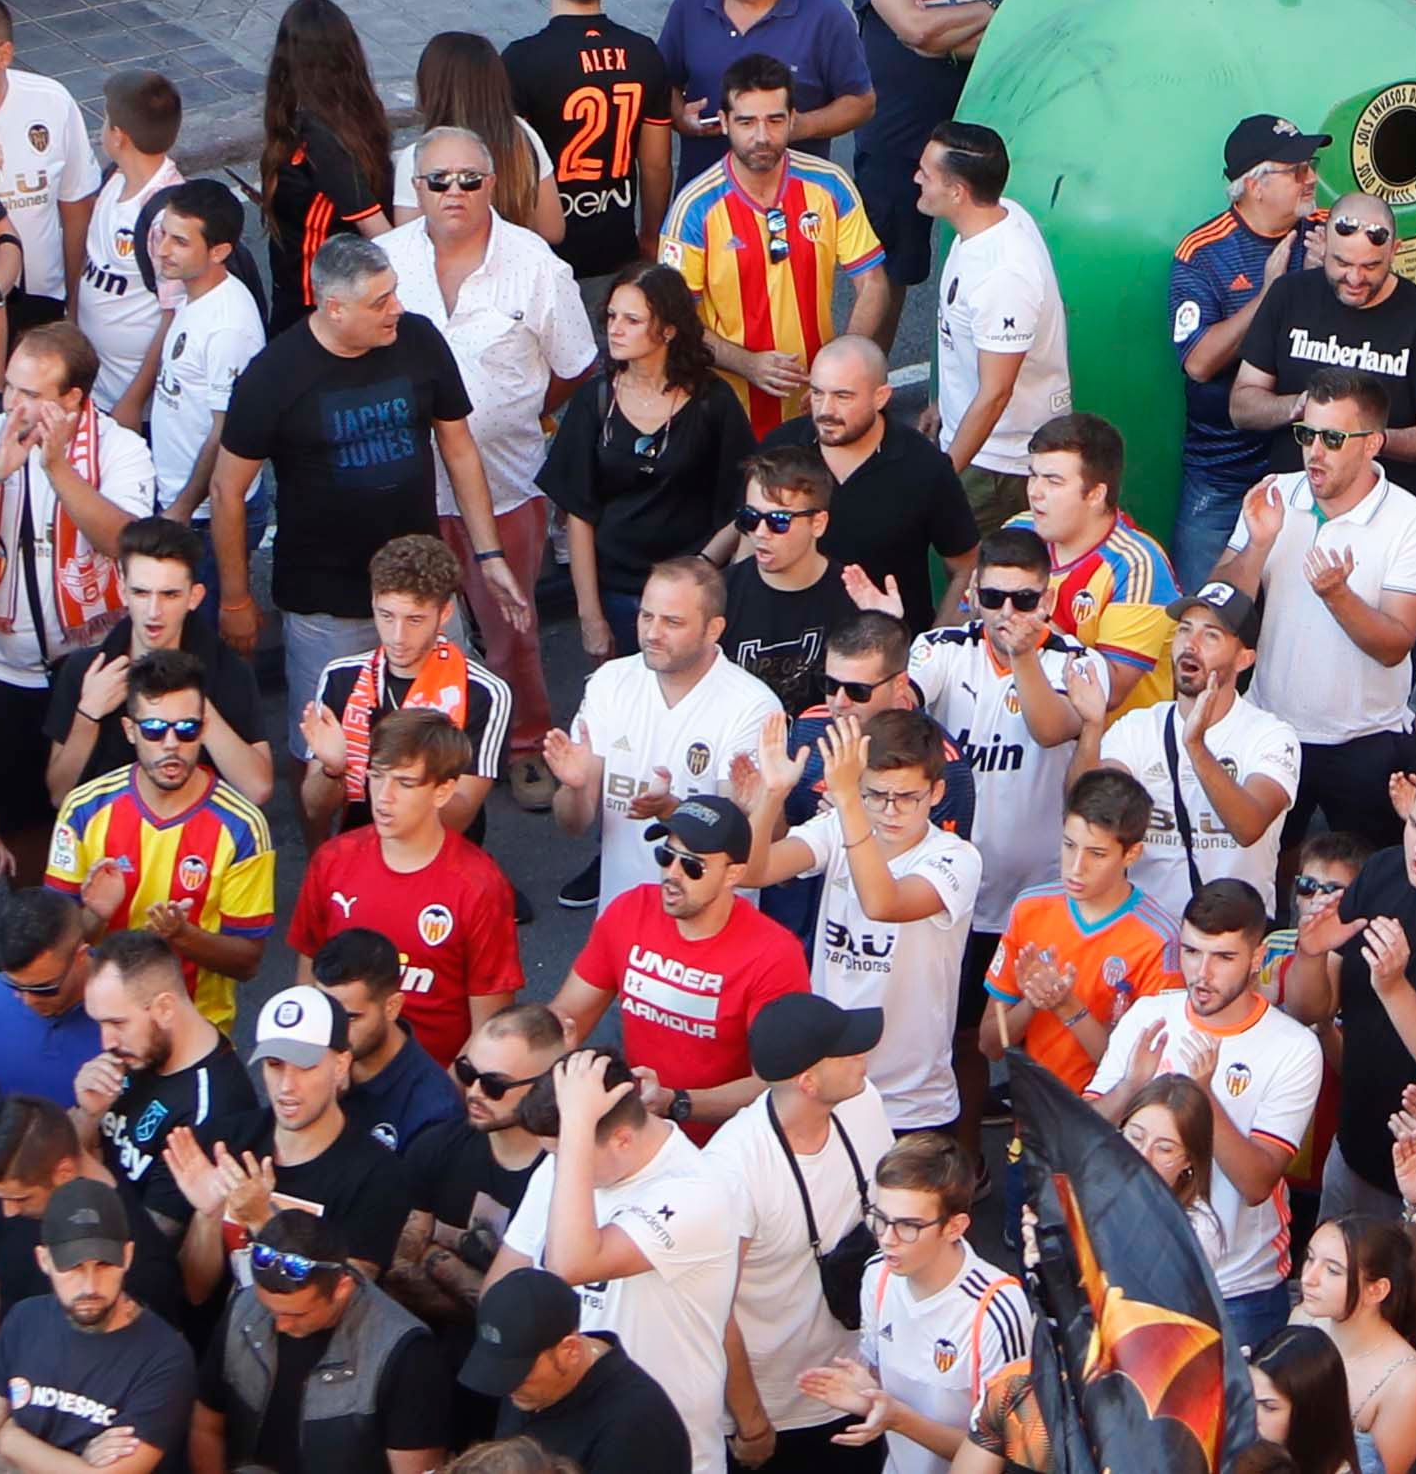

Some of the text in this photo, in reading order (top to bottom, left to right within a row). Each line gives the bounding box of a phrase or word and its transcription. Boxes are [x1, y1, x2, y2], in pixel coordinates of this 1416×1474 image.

[579, 48, 628, 74] ALEX
[557, 82, 642, 184] 21
[80, 260, 129, 296] win
[1288, 327, 1410, 377] Timberland
[824, 918, 895, 959] BLÜ
[628, 944, 725, 994] UNDER
[620, 997, 717, 1041] ARMOUR
